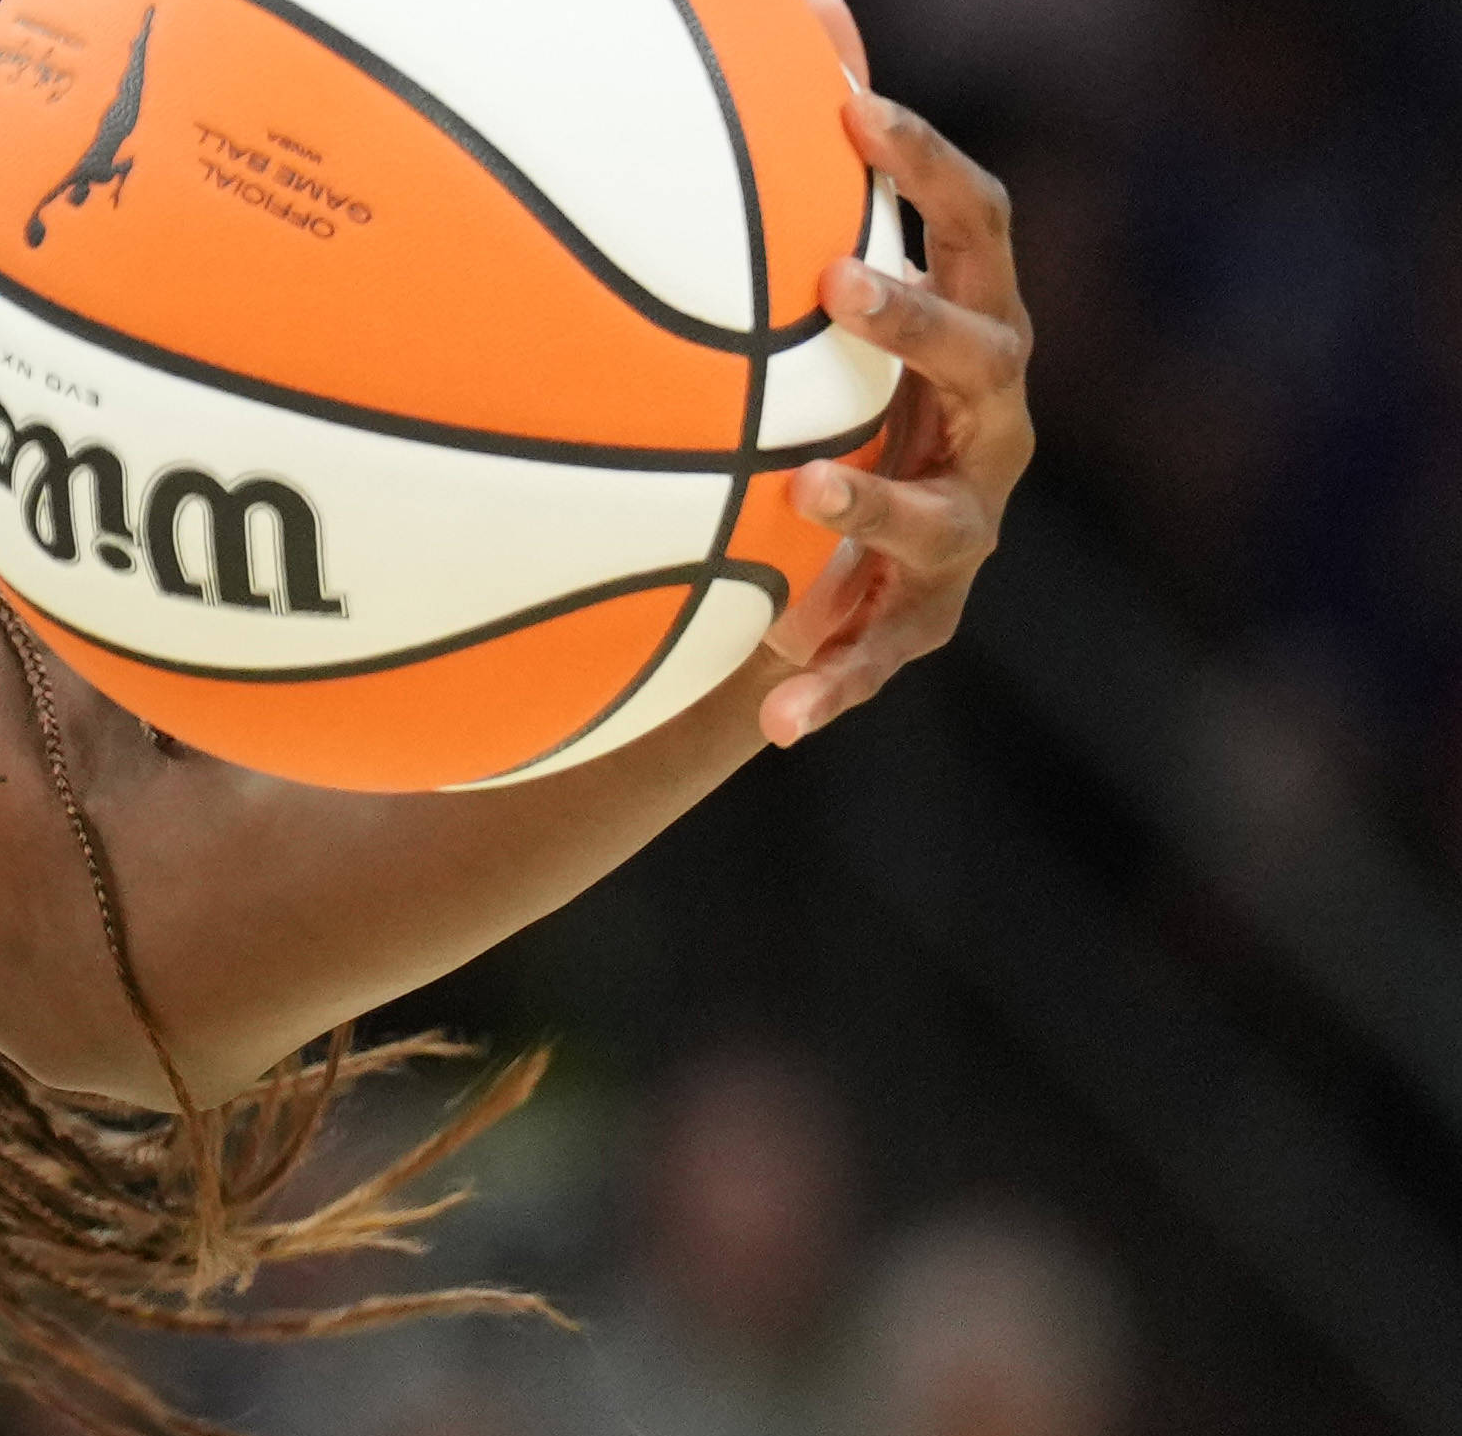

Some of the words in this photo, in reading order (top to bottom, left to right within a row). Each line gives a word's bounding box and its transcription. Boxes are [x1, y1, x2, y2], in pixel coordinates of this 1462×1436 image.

[194, 124, 271, 172] BALL
[200, 158, 336, 240] OFFICIAL
[276, 165, 374, 225] GAME
[46, 371, 100, 408] EVO
